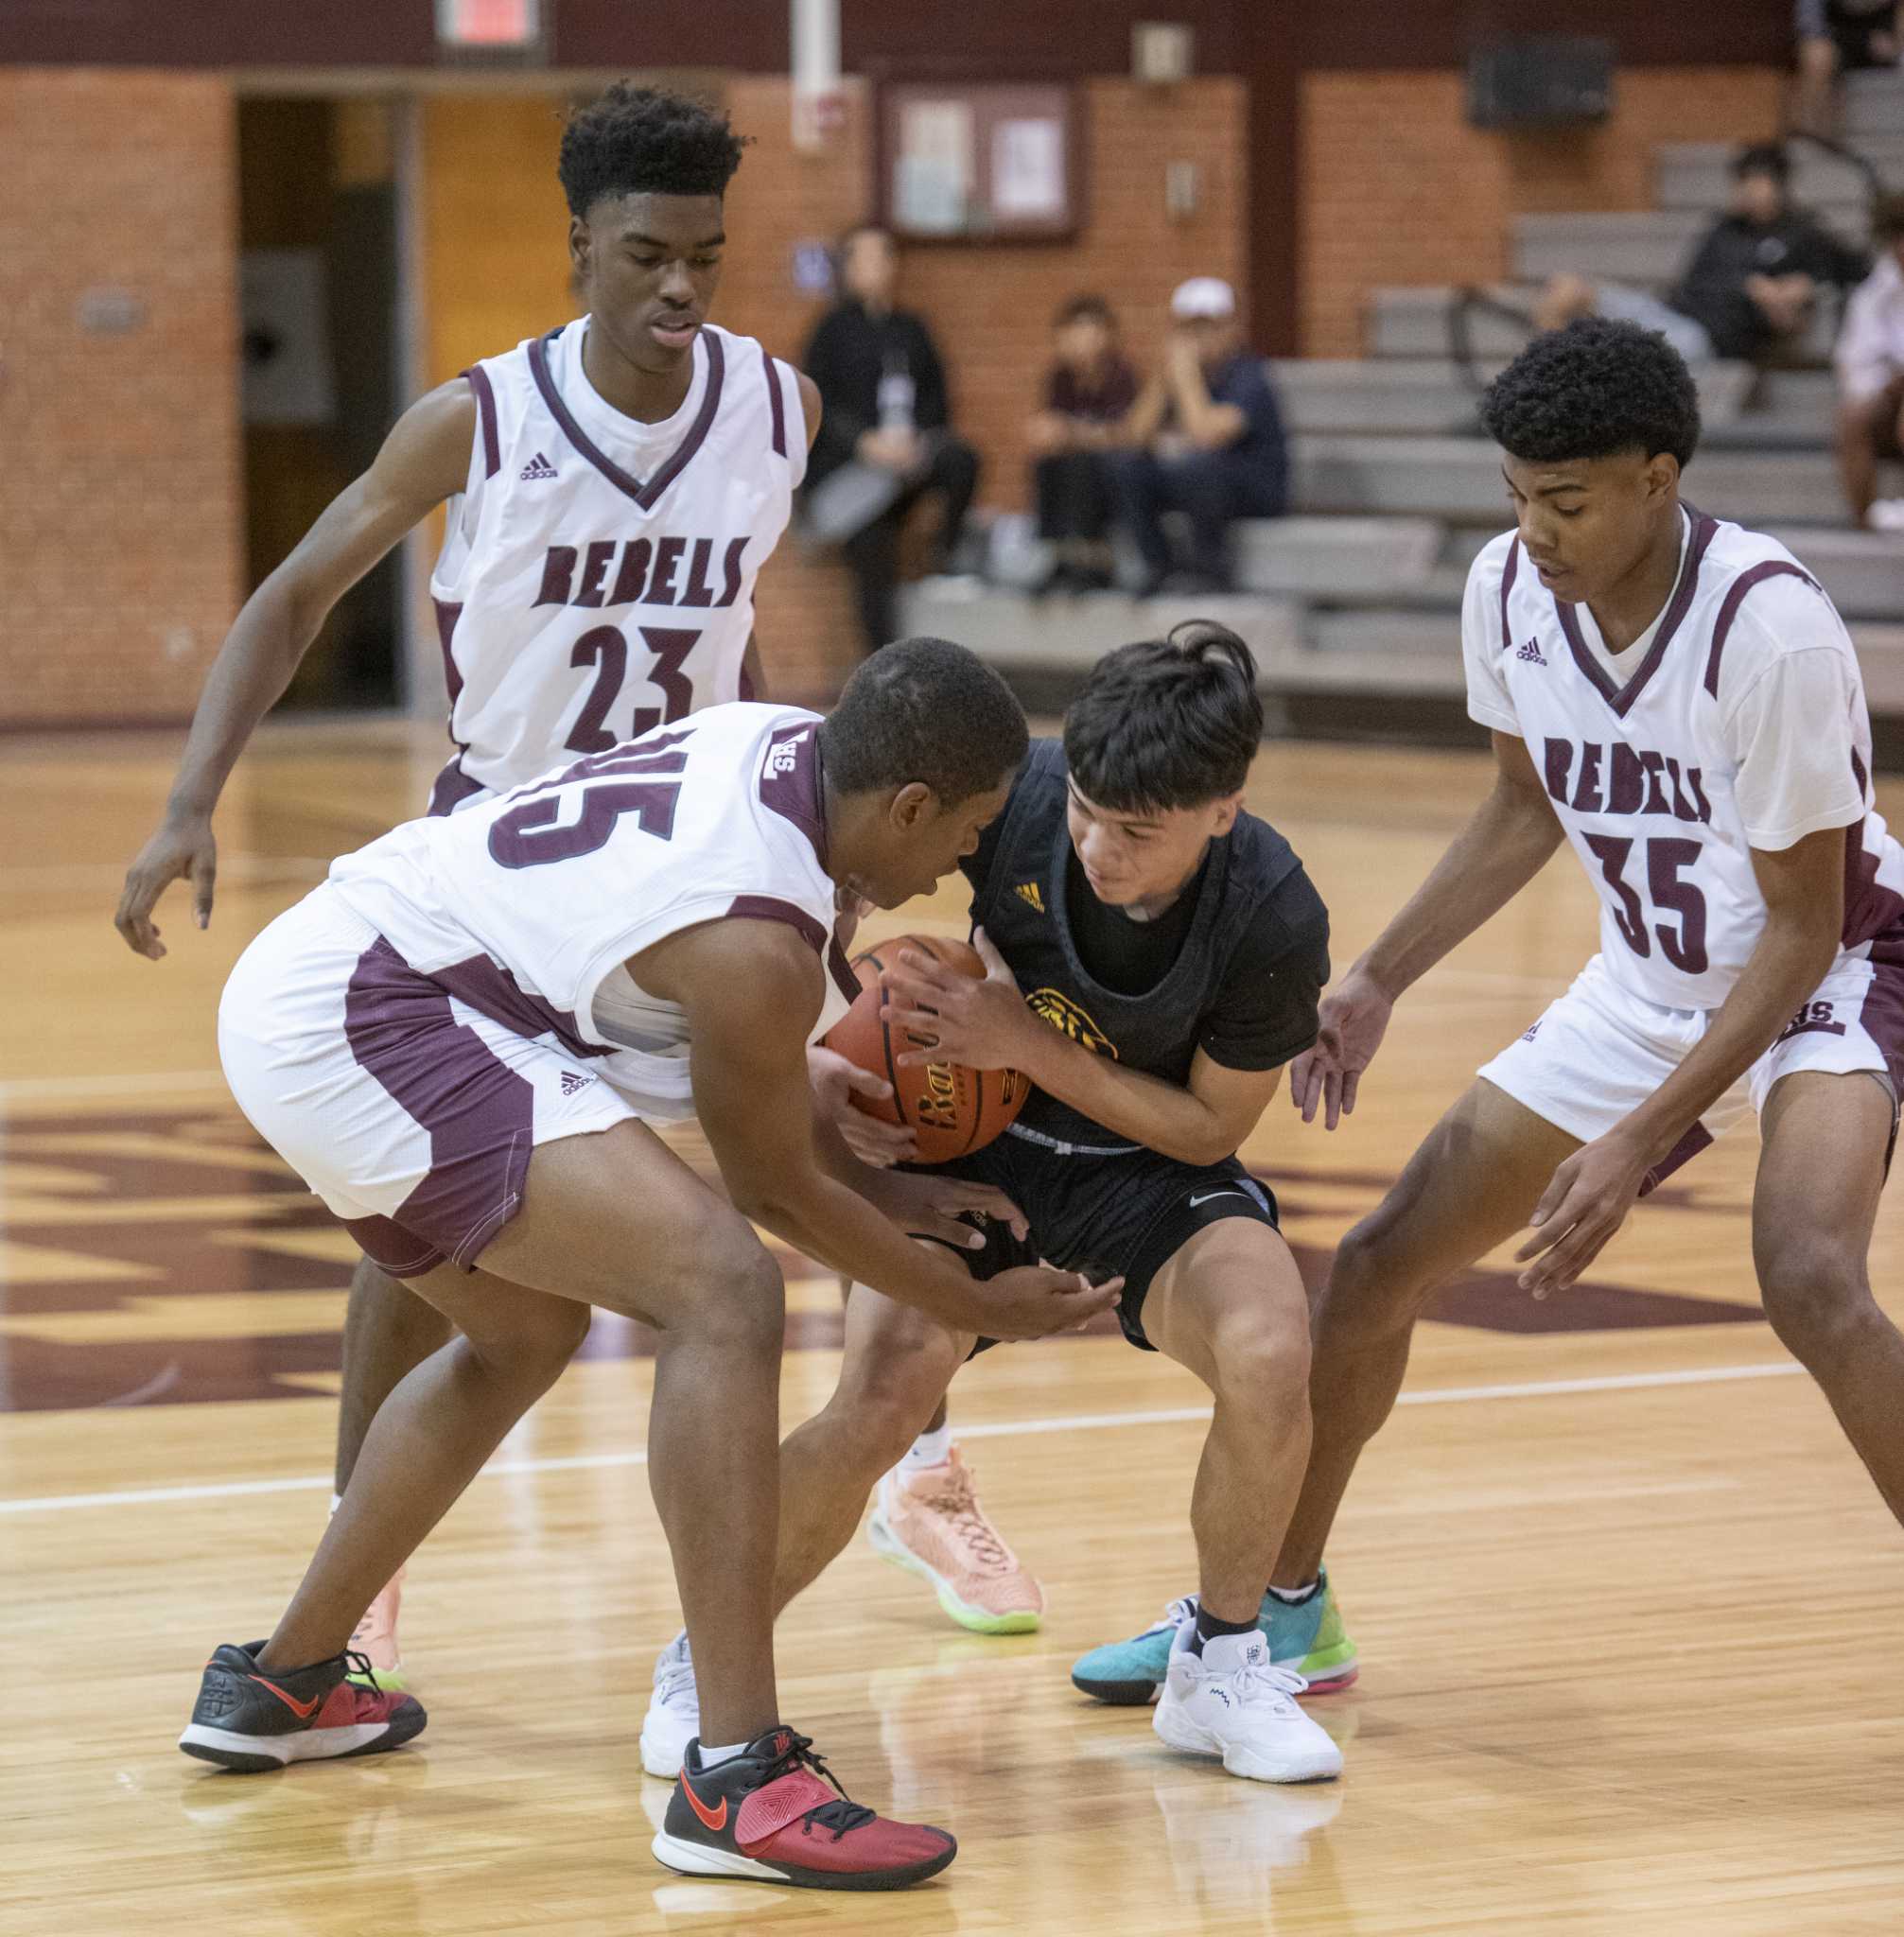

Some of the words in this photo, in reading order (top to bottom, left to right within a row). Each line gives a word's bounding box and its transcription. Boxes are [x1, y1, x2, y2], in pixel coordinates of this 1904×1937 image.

[521, 470, 558, 480] adidas
[530, 536, 752, 608] REBELS
[1516, 651, 1547, 667] adidas
[564, 625, 702, 754] 23
[1581, 830, 1709, 975] 35
[563, 1077, 591, 1096] adidas
